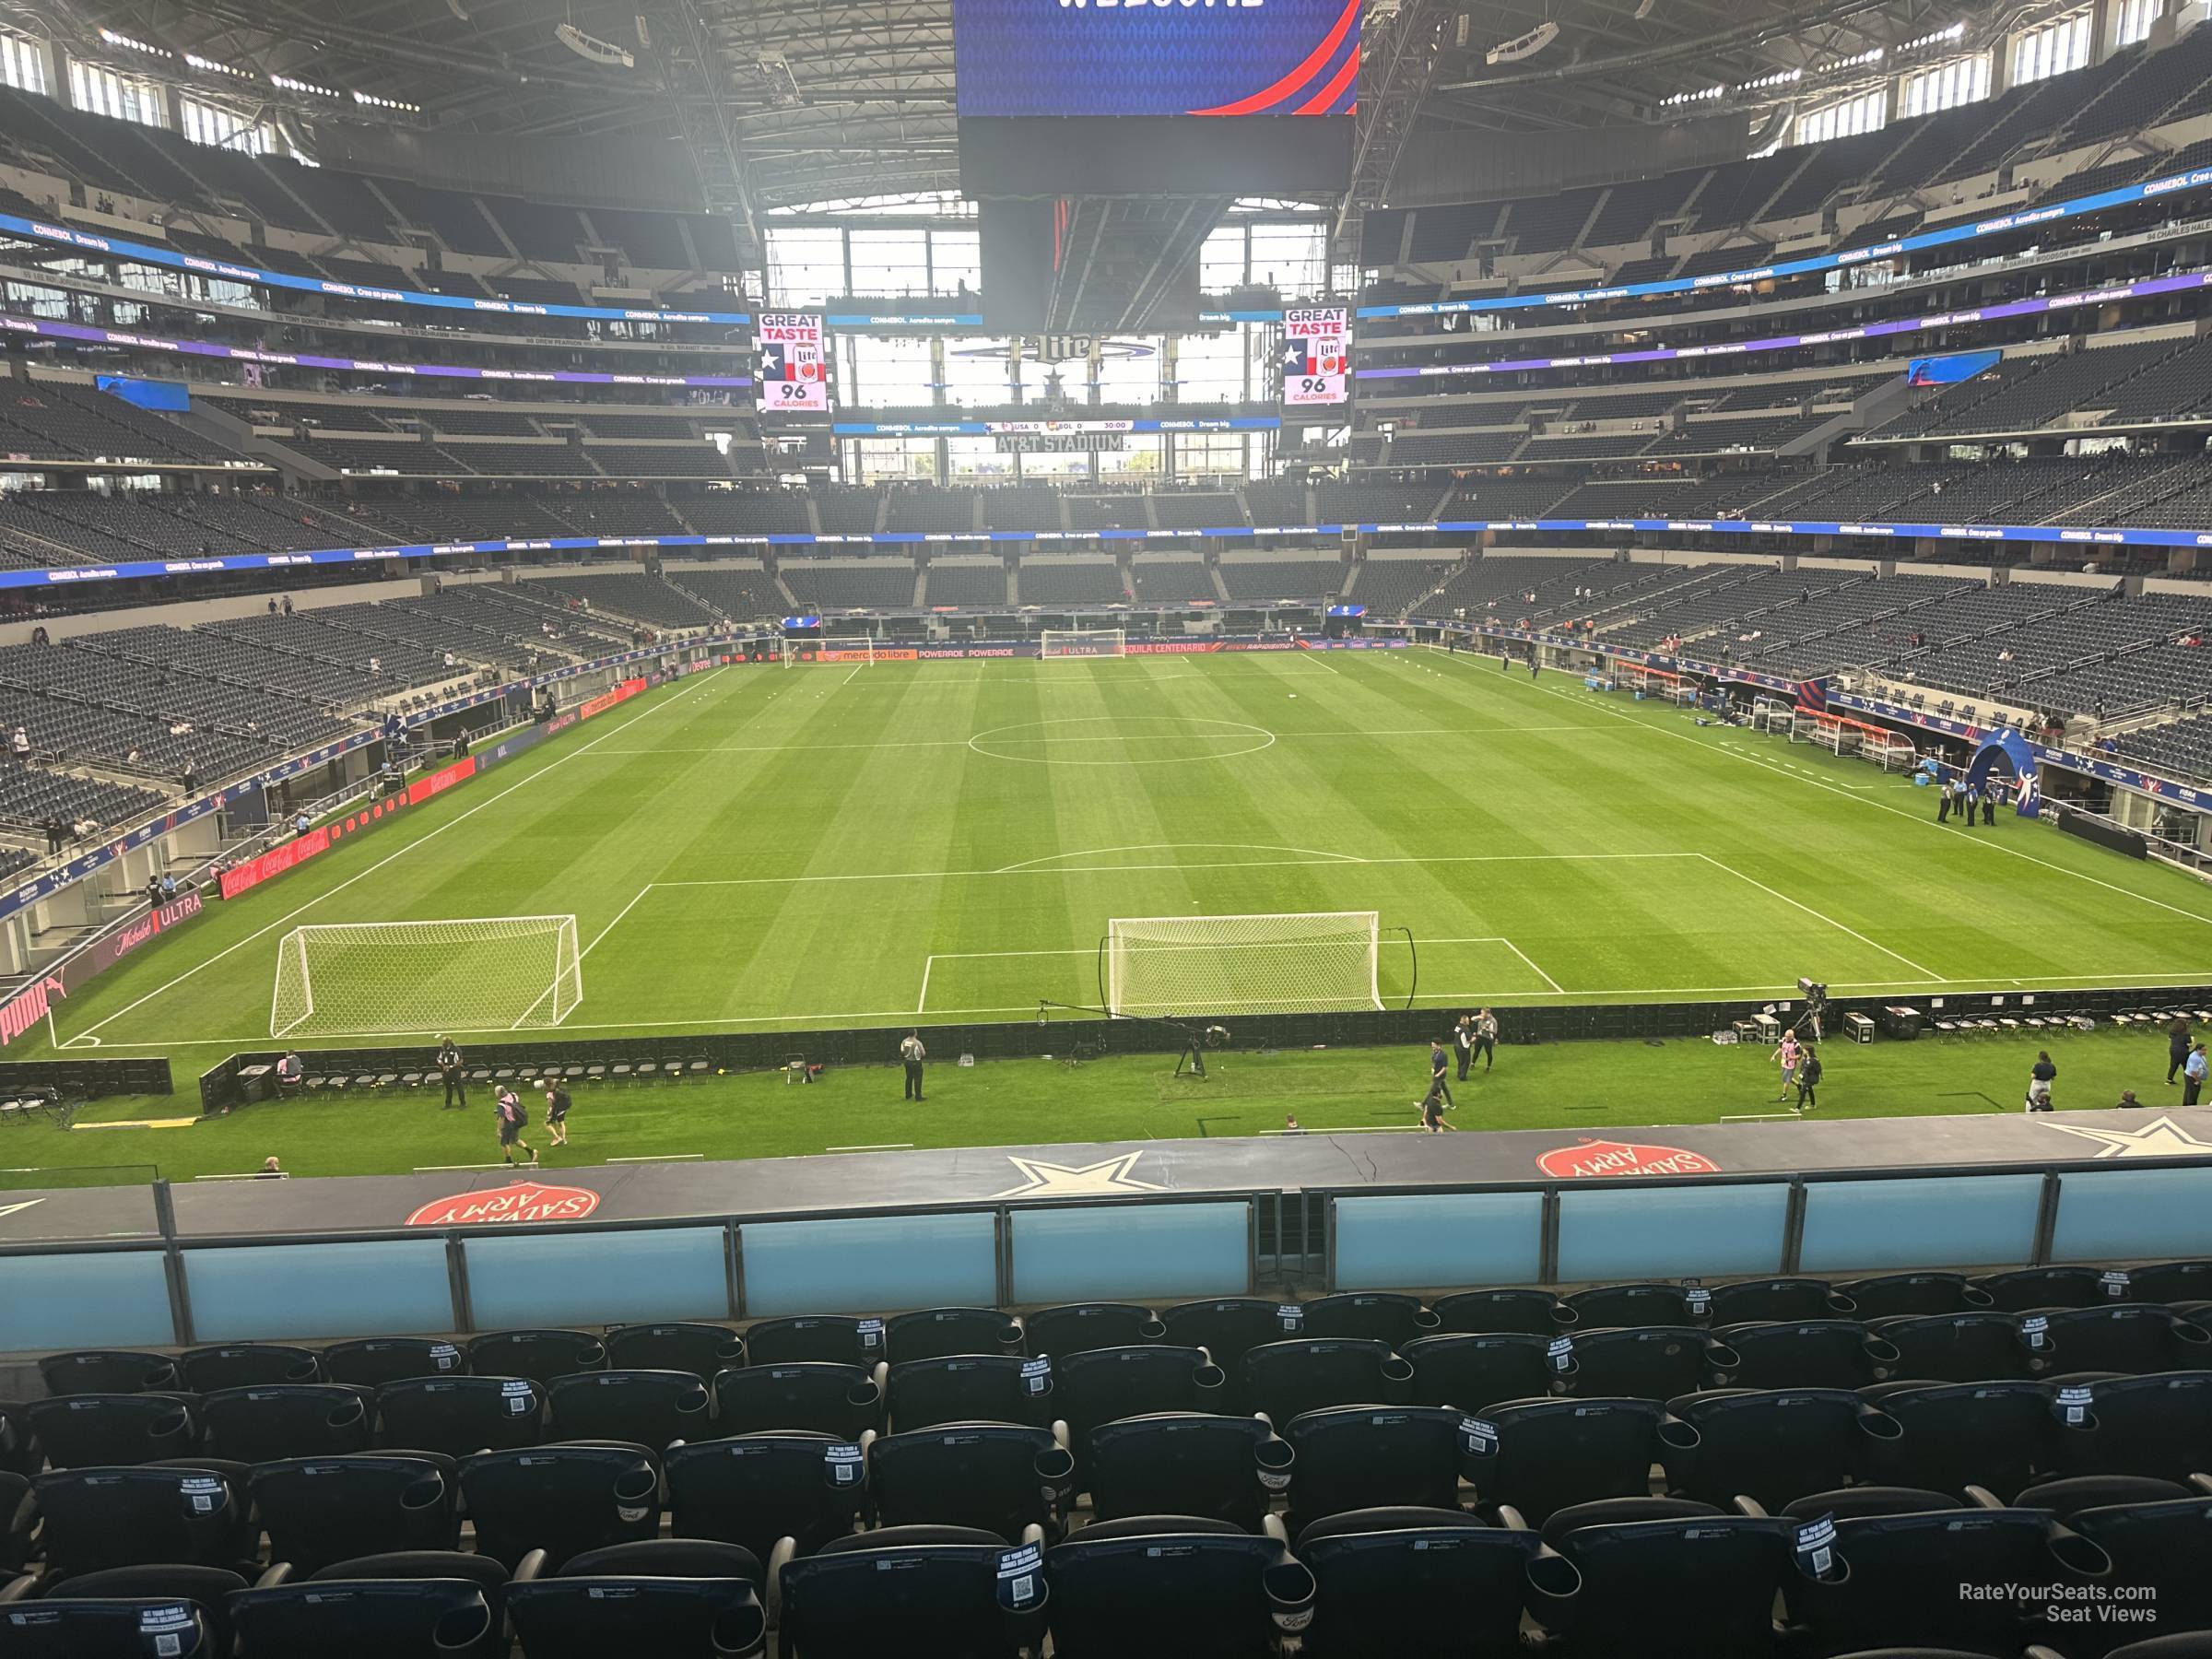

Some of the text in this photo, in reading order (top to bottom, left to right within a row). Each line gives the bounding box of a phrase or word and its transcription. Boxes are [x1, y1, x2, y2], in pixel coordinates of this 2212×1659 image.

[2156, 226, 2190, 240] CHARLES
[762, 314, 818, 326] GREAT
[1288, 310, 1343, 321] GREAT
[764, 328, 818, 340] TASTE
[1289, 323, 1341, 335] TASTE
[1037, 335, 1091, 365] Lite
[1321, 345, 1337, 356] Lite
[797, 351, 816, 362] Lite
[781, 384, 806, 399] 96
[1301, 379, 1325, 392] 96
[1293, 393, 1336, 401] CALORIES
[997, 435, 1124, 452] AT&T STADIUM
[888, 650, 910, 658] libre
[919, 650, 964, 658] POWERADE
[969, 649, 1014, 657] POWERADE
[1156, 643, 1206, 653] CENTENARIO
[115, 894, 202, 957] Michelob ULTRA
[0, 982, 48, 1046] PUMA
[1571, 1147, 1638, 1177] ARMY
[429, 1190, 546, 1224] ARMY
